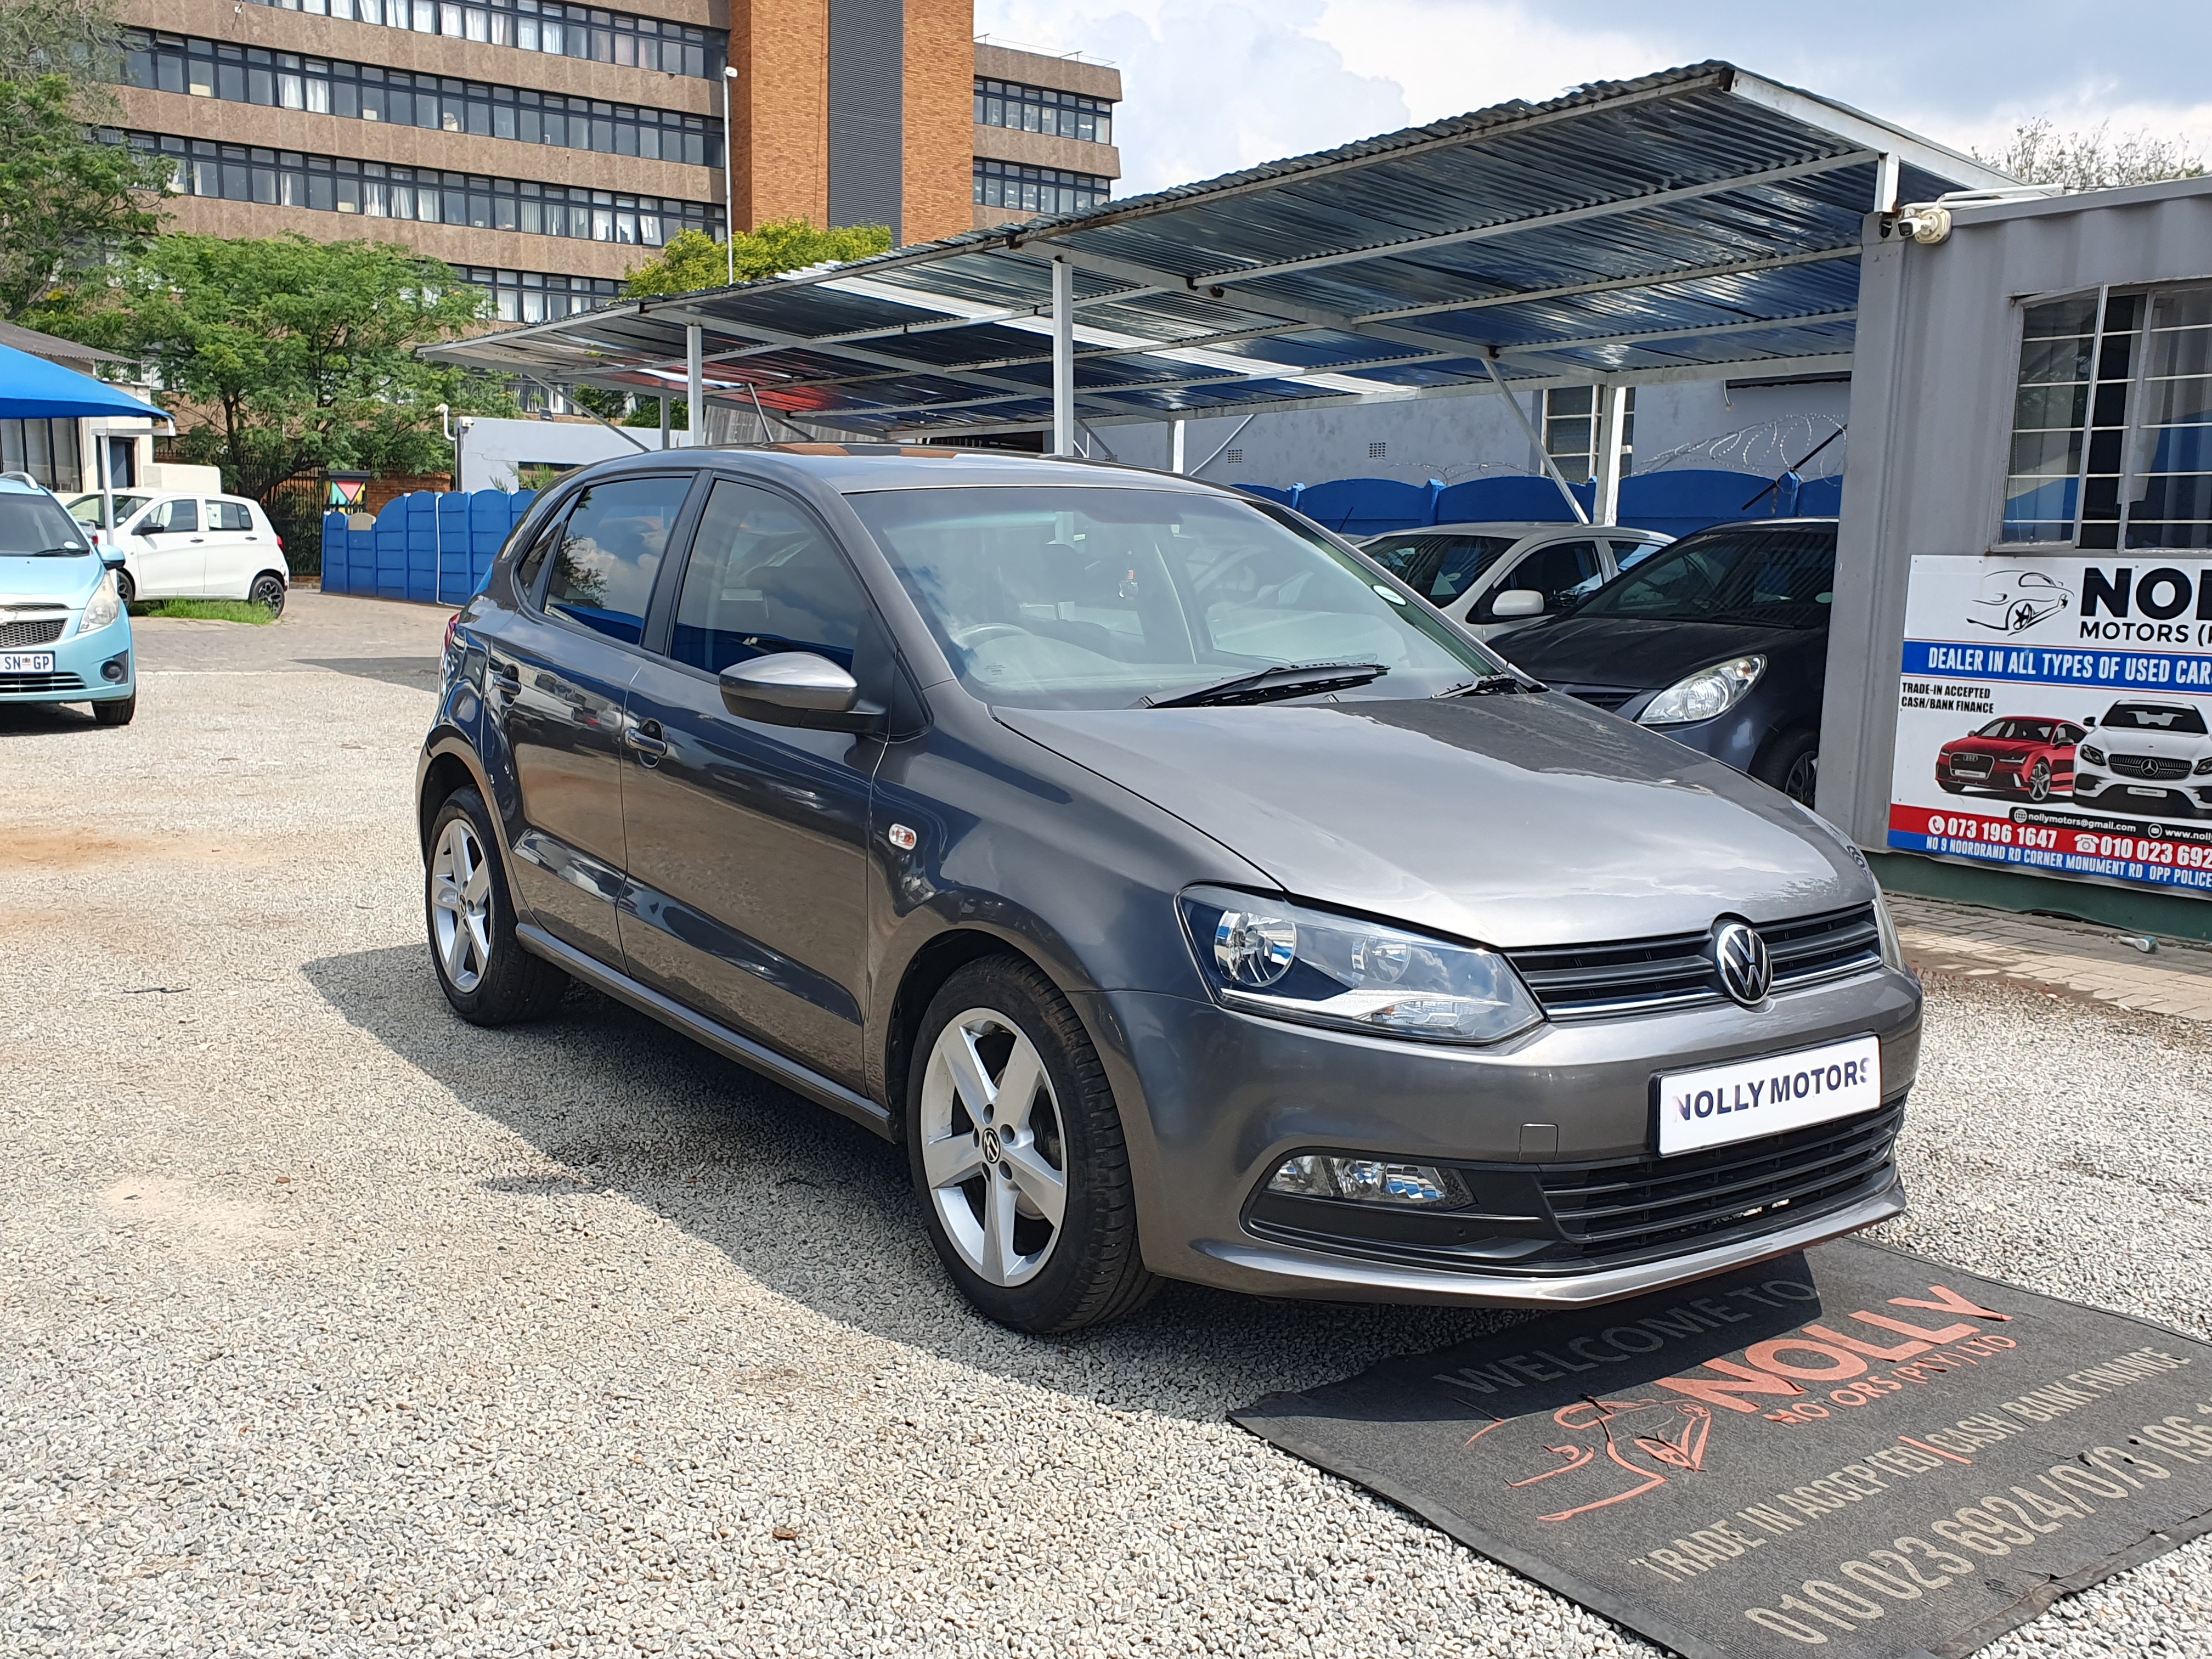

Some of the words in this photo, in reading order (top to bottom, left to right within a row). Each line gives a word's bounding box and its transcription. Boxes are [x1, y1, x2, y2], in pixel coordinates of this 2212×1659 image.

[2080, 621, 2189, 642] MOTORS
[4, 656, 21, 670] SN
[33, 656, 49, 670] GP
[1928, 647, 1983, 671] DEALER
[1988, 650, 2004, 672] IN
[2007, 651, 2036, 674] ALL
[2042, 653, 2094, 678] TYPES
[2098, 656, 2120, 679] OF
[2125, 657, 2170, 682] USED
[2176, 660, 2212, 685] CAR
[1901, 696, 1954, 710] CASH/BANK
[1956, 701, 1994, 714] FINANCE
[1902, 682, 1943, 696] TRADE-IN
[1944, 686, 1990, 699] ACCEPTED
[1948, 817, 1977, 838] 073
[1982, 822, 2012, 843] 196
[2017, 827, 2057, 848] 1647
[2100, 836, 2133, 858] 010
[2137, 840, 2173, 864] 023
[2177, 845, 2212, 868] 692
[2028, 813, 2136, 832] nollymotors@gmail.com
[1926, 836, 1938, 850] NO
[1940, 839, 1946, 851] 9
[1949, 839, 2005, 859] NOORDRAND
[2008, 848, 2021, 862] RD
[2024, 849, 2063, 867] CORNER
[2066, 854, 2126, 876] MONUMENT
[2128, 862, 2143, 878] RD
[2149, 865, 2171, 882] OPP
[2174, 868, 2212, 887] POLICE
[1673, 1079, 1765, 1121] NOLLY
[1770, 1058, 1871, 1104] MOTORS
[1432, 1297, 1752, 1394] WELCOME
[1724, 1279, 1816, 1308] TO
[1654, 1284, 2013, 1413] NOLLY
[1956, 1335, 2017, 1357] LTD
[1628, 1519, 1768, 1583] TRADE
[1735, 1503, 1805, 1535] IN
[1776, 1446, 1945, 1520] ACCEPTED
[2067, 1346, 2192, 1392] FINANCE
[1745, 1580, 1884, 1644] 010
[1840, 1537, 1975, 1600] 023
